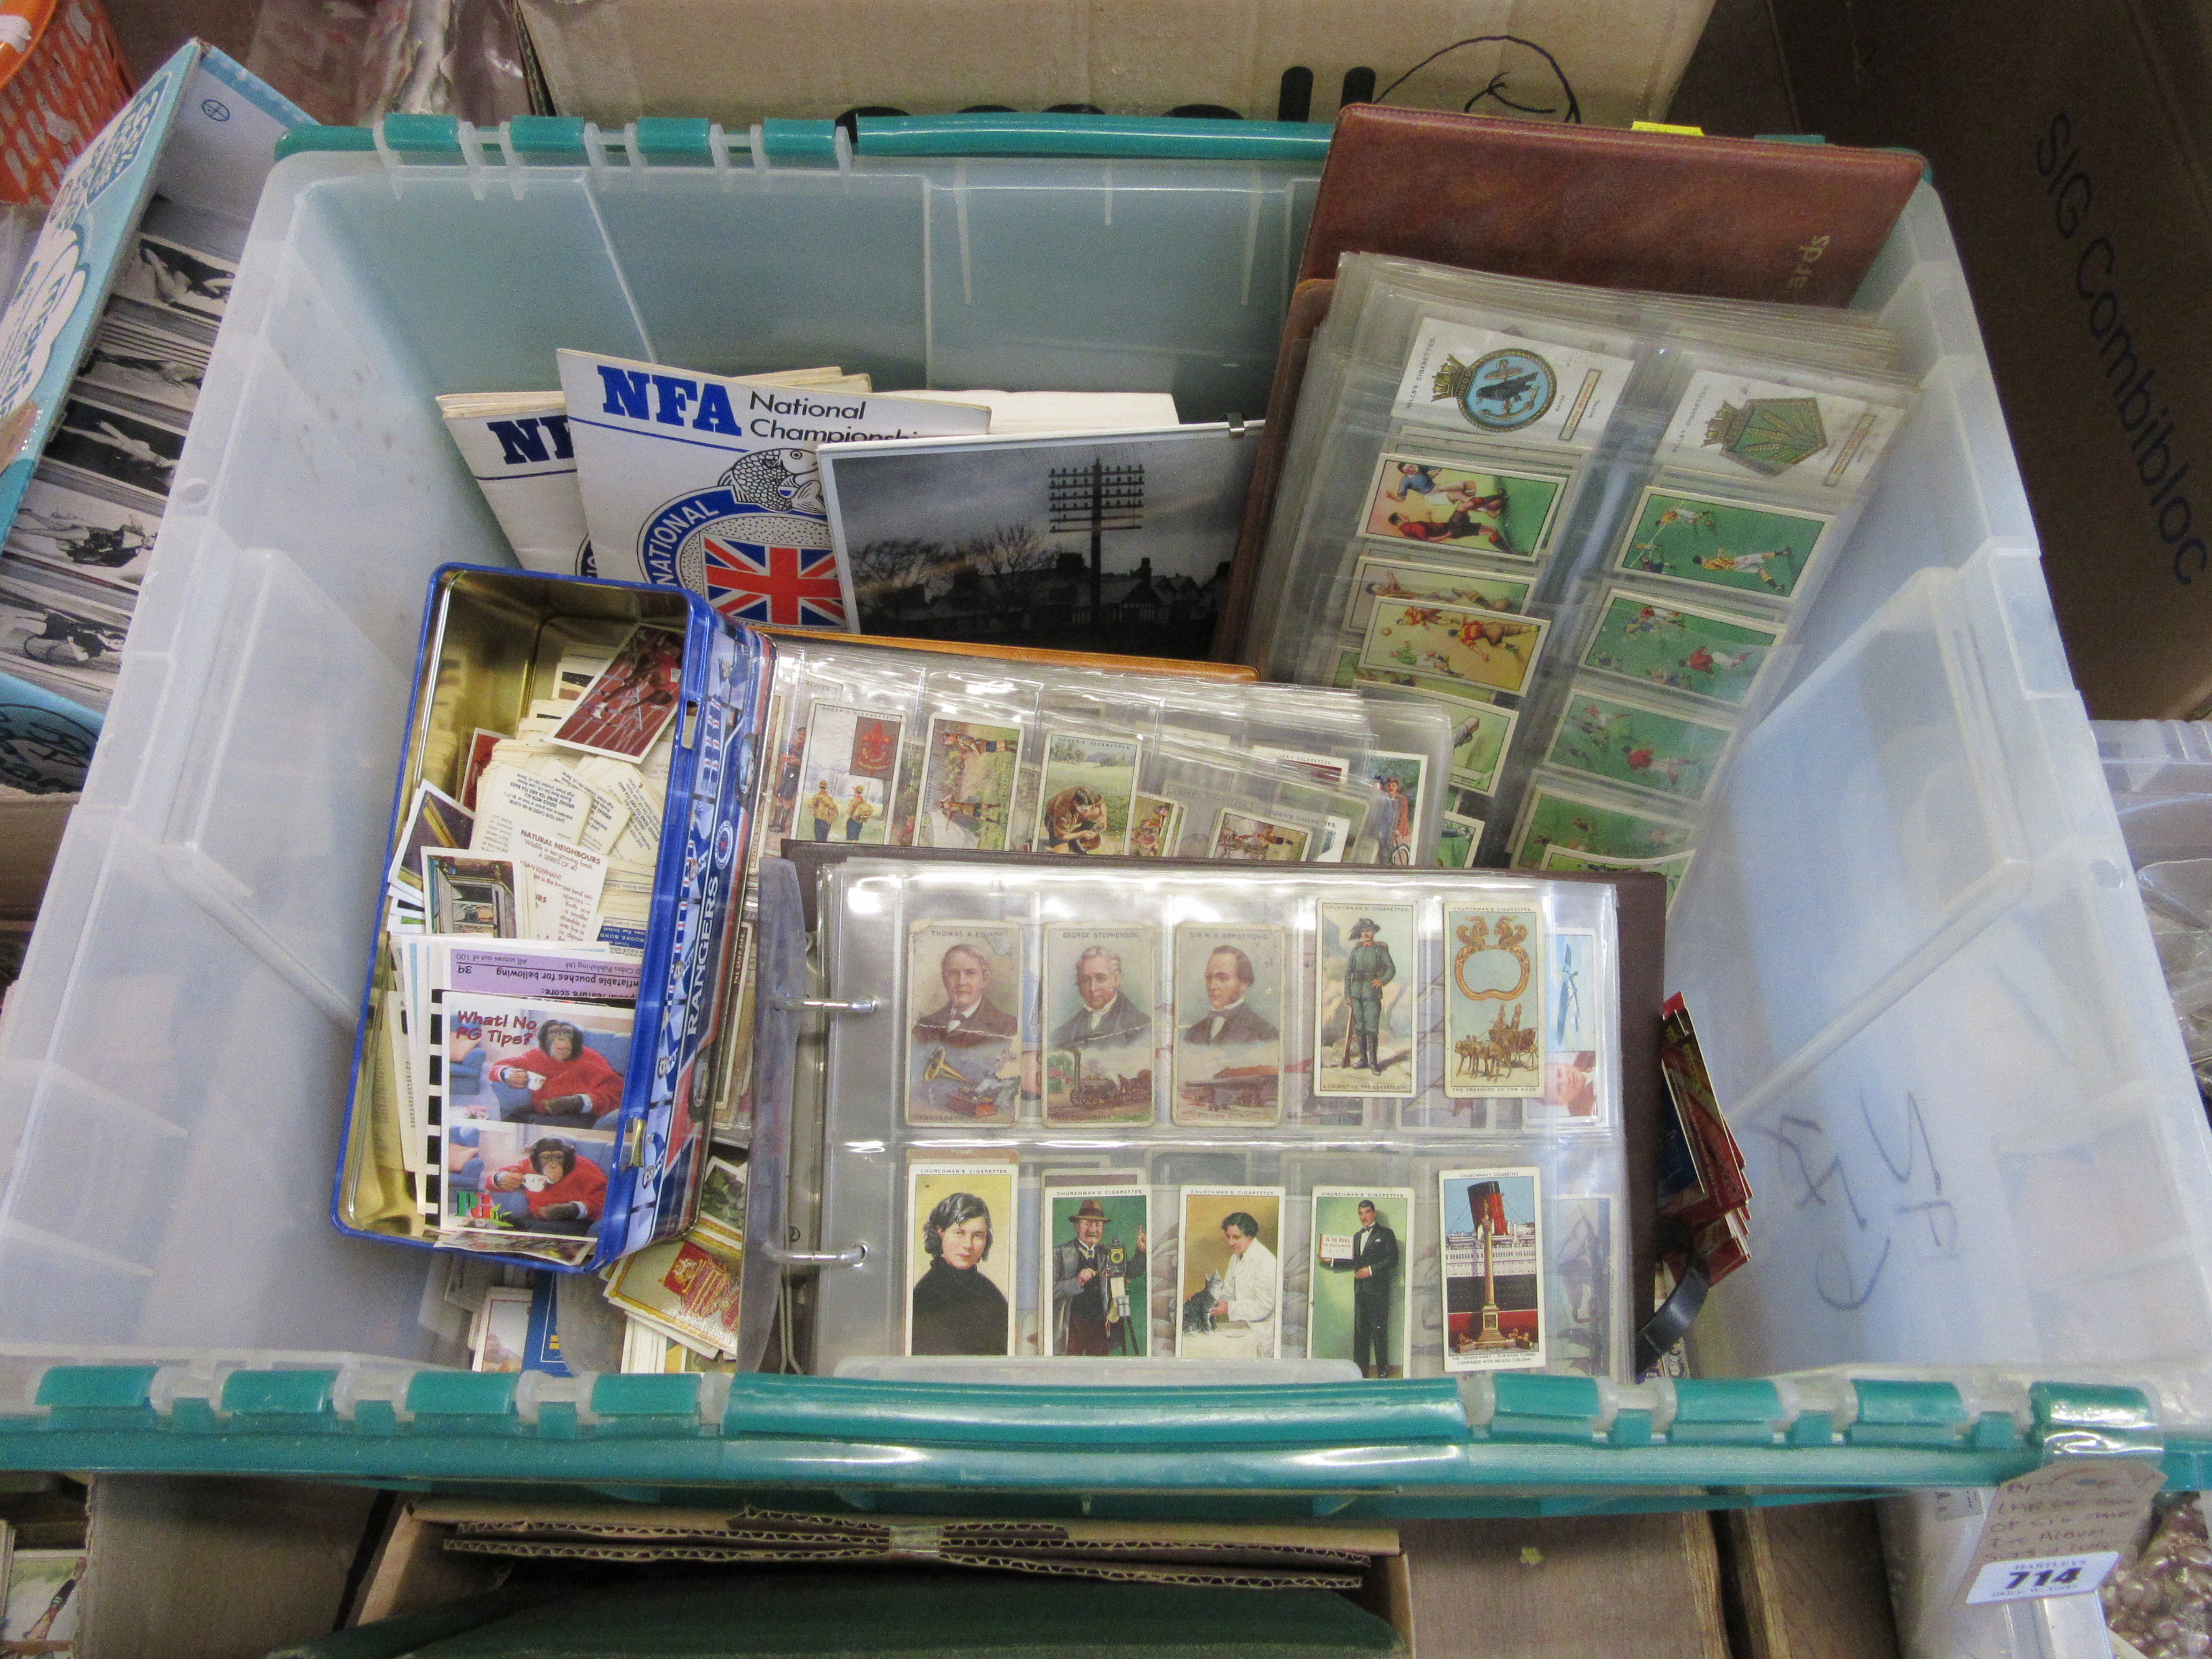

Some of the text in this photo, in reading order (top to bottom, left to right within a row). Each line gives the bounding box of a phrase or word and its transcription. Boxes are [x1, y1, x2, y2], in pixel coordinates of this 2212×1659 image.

[2036, 112, 2207, 585] SIG Combibloc
[597, 365, 742, 436] NFA
[750, 391, 866, 419] National
[649, 500, 720, 586] NATIONAL
[520, 830, 553, 847] NATURAL
[554, 842, 601, 865] NEIGHBOURS
[525, 840, 544, 851] Wildlife
[580, 860, 593, 870] lands
[544, 854, 560, 865] SERIES
[536, 867, 562, 880] ELEPHANT
[565, 901, 577, 909] Both
[685, 876, 718, 1035] RANGERS
[513, 1015, 537, 1030] No
[456, 1027, 533, 1048] PG Tips?
[2006, 1567, 2083, 1591] 714
